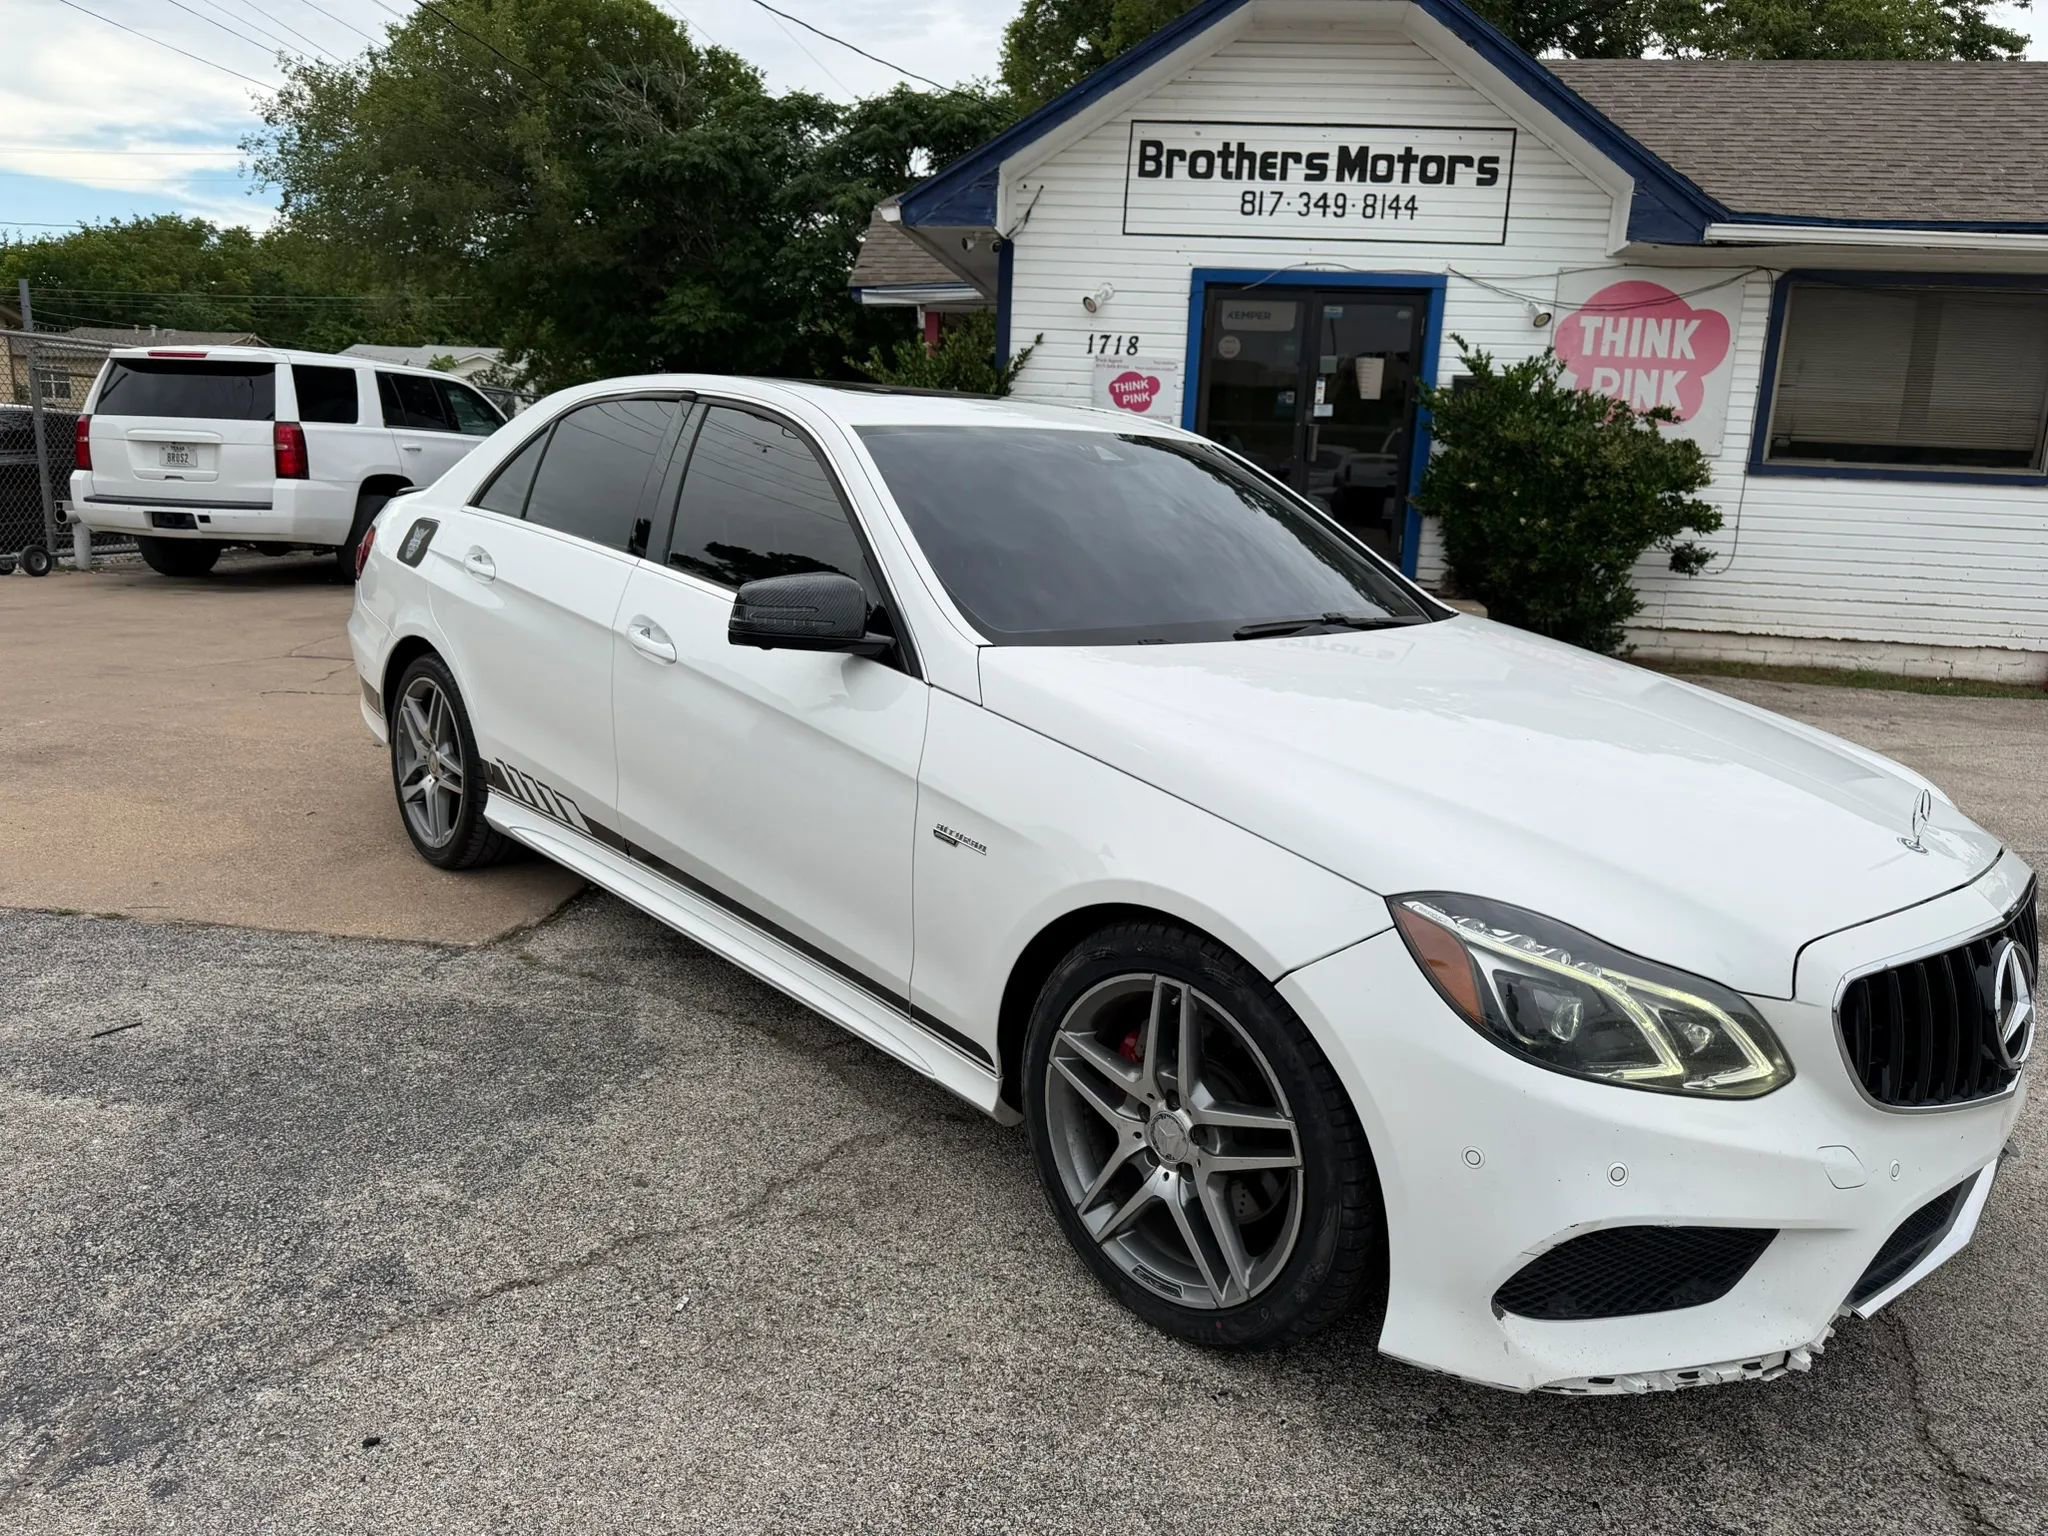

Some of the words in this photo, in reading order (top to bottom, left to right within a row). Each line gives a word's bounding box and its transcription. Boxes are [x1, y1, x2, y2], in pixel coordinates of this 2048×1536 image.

[1138, 139, 1330, 182] Brothers
[1335, 145, 1500, 186] Motors
[1086, 333, 1140, 356] 1718
[1579, 316, 1702, 360] THINK
[1112, 379, 1150, 394] THINK
[1122, 391, 1151, 406] PINK
[1591, 367, 1688, 411] PINK
